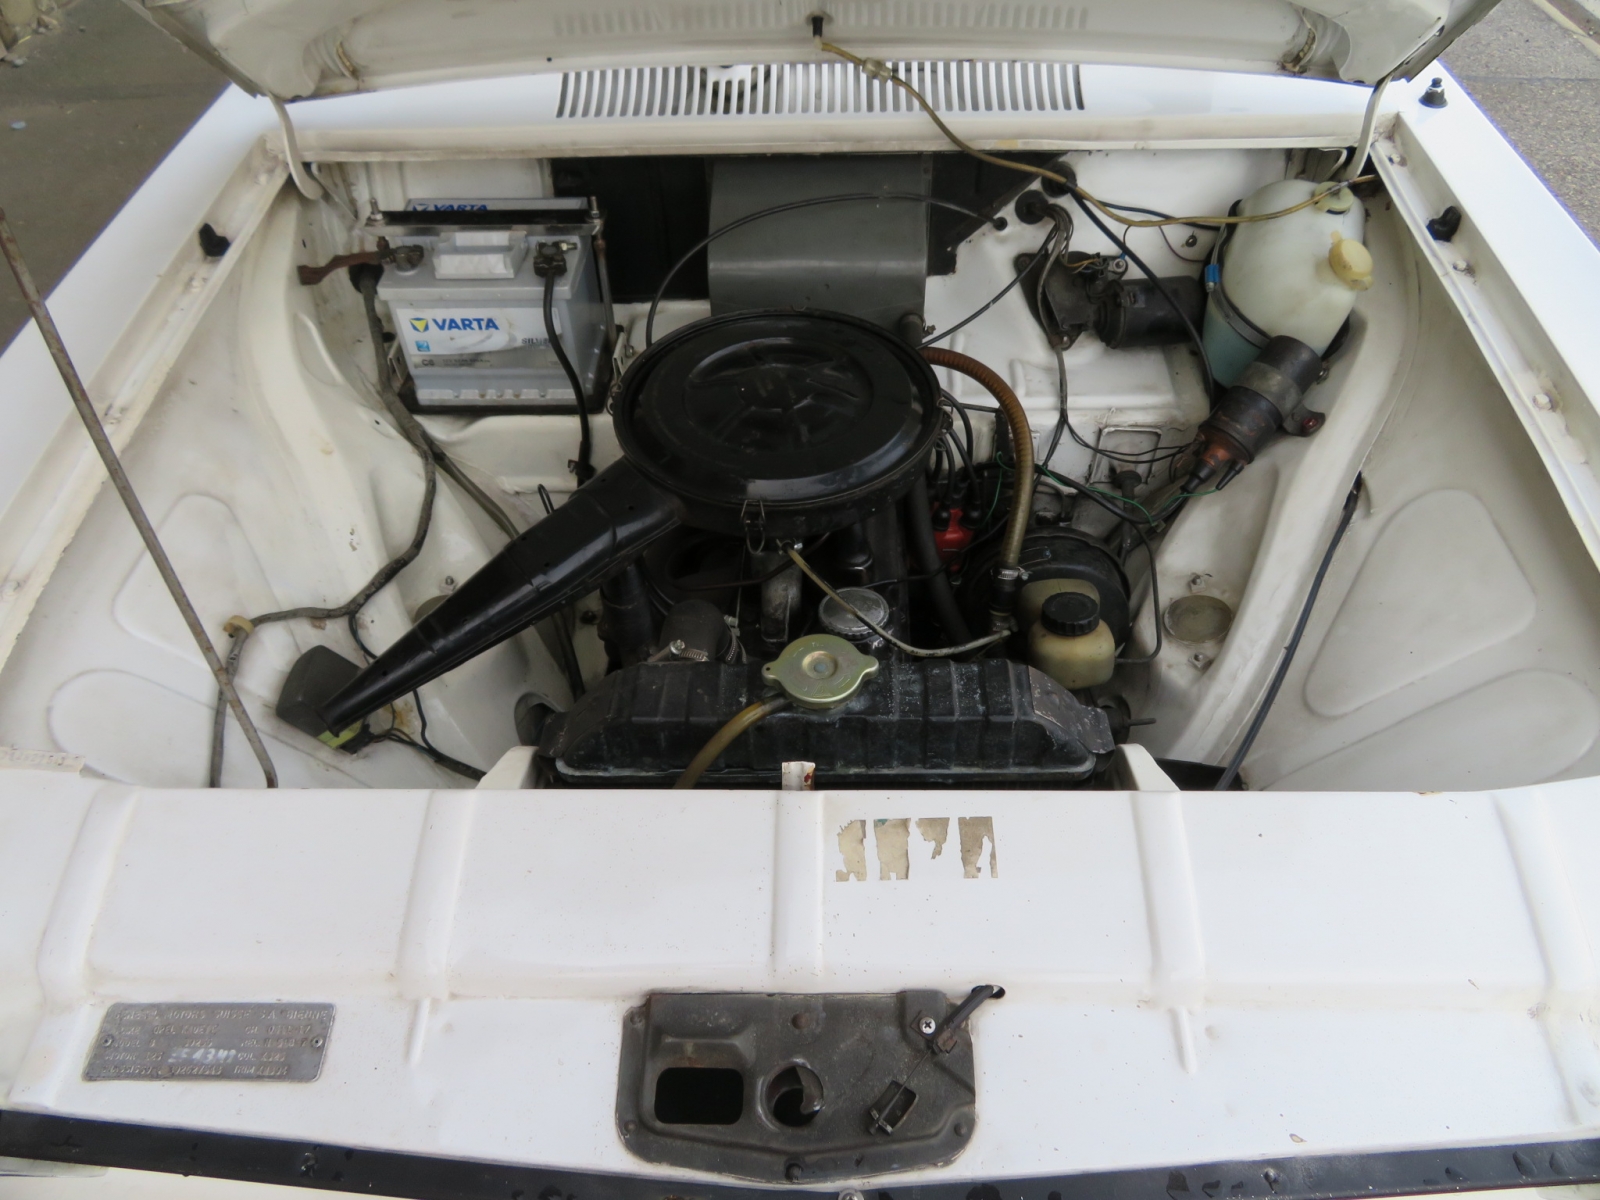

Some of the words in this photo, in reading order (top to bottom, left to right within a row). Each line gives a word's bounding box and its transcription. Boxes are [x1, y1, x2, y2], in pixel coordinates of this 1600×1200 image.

[433, 203, 488, 212] VARTA
[431, 317, 501, 331] VARTA
[164, 1010, 205, 1020] MOTORS
[153, 1024, 176, 1035] OPEL
